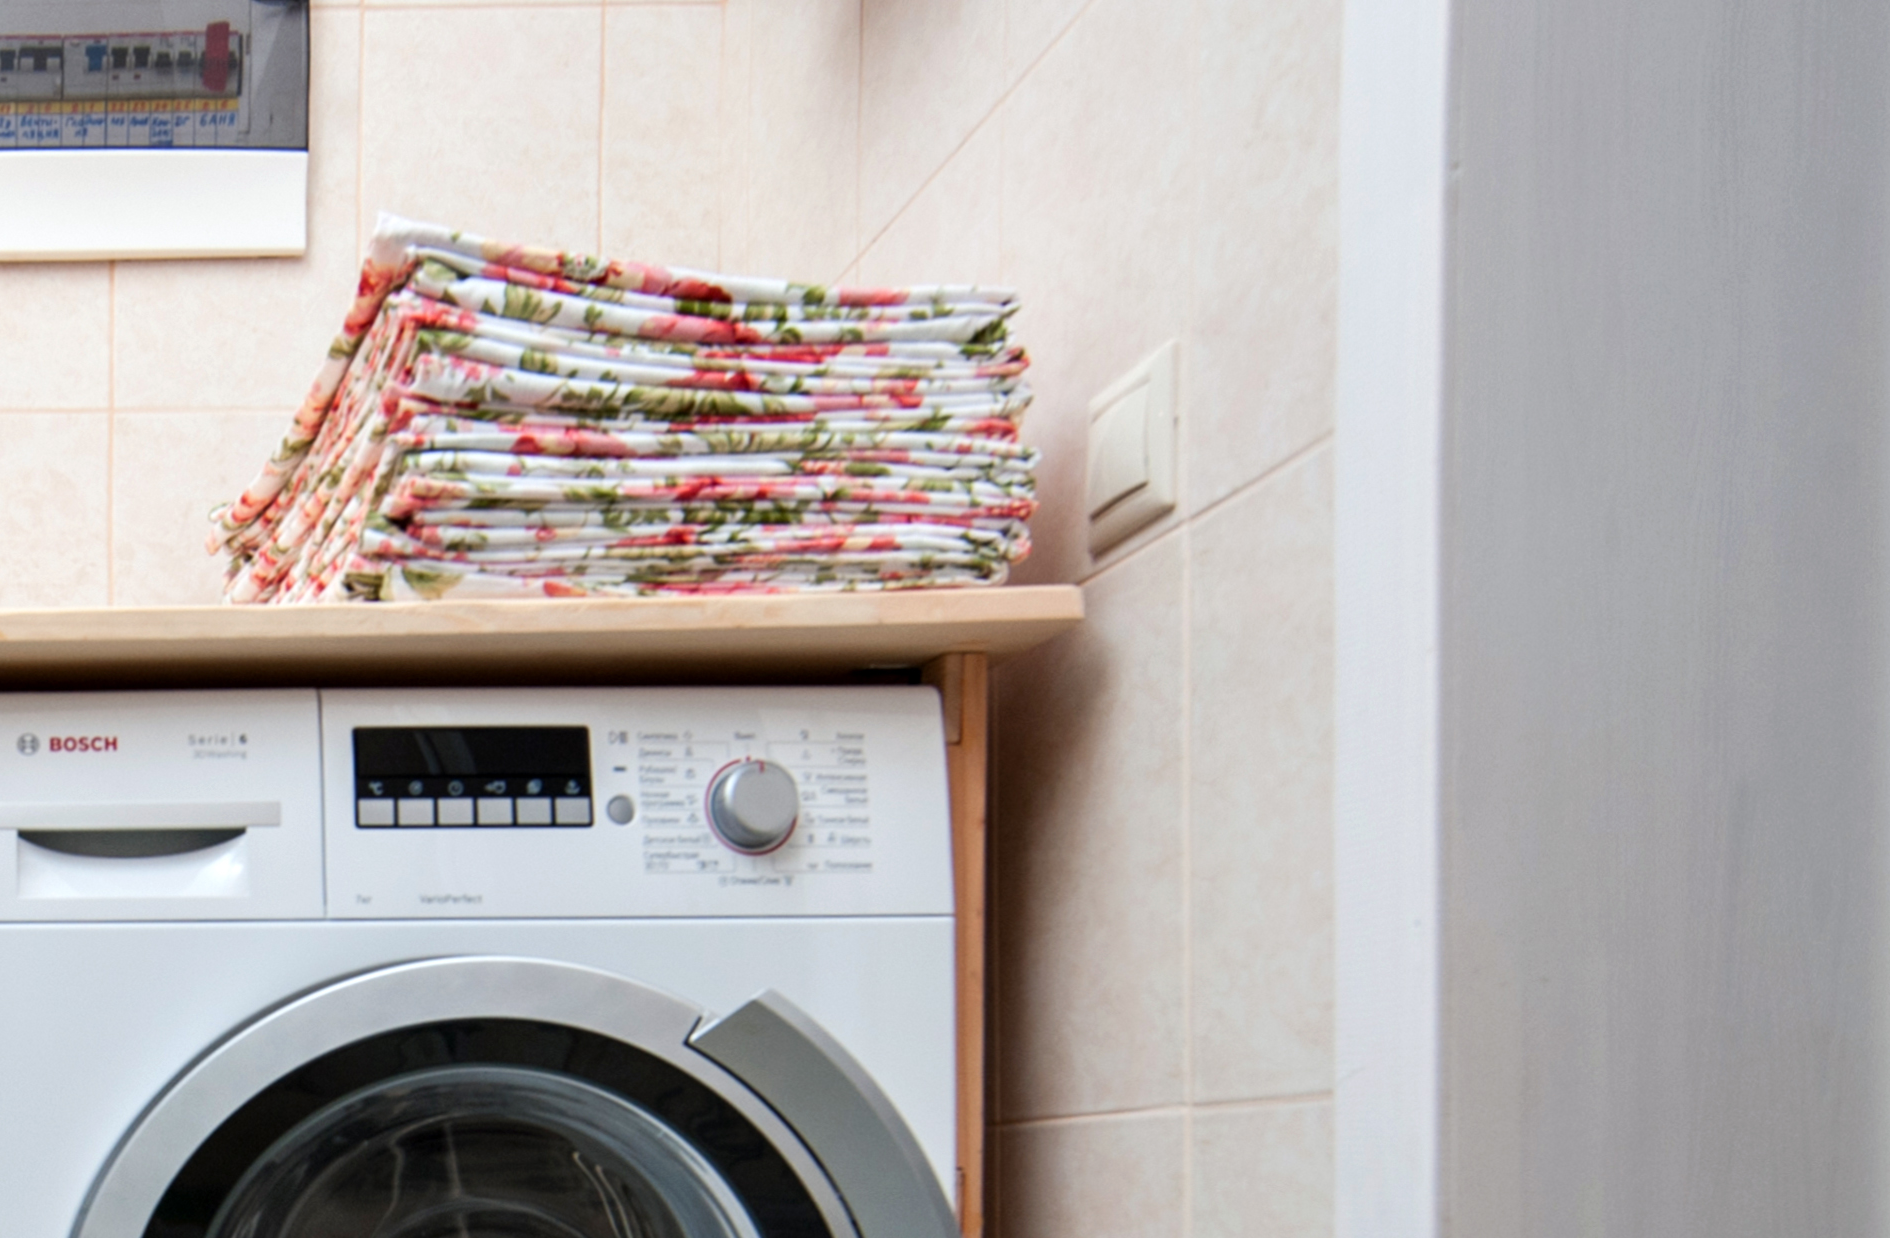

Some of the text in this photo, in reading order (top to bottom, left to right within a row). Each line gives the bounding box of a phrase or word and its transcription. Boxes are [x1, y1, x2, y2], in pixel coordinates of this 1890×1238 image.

[49, 736, 118, 752] BOSCH
[188, 733, 248, 746] Serie 6
